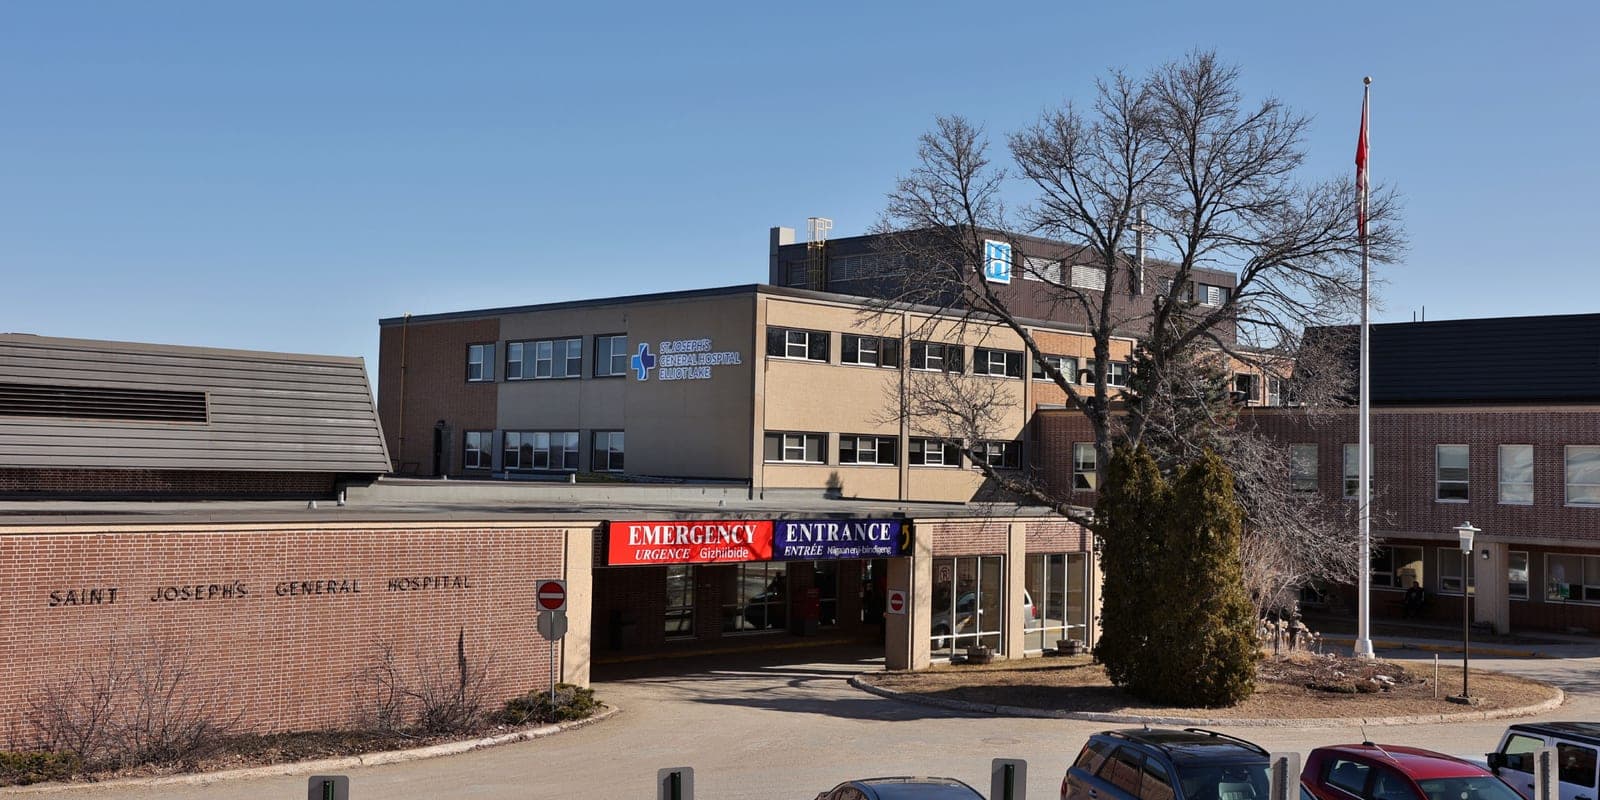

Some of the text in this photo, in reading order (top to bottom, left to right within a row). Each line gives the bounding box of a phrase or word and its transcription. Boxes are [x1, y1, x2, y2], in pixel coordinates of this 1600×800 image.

[660, 352, 740, 367] GENERAL HOSPITAL
[660, 366, 711, 380] ELLIOT LAKE
[627, 522, 892, 546] EMERGENCY ENTRANCE
[635, 546, 750, 561] URGENCE Gizhiibide
[783, 543, 824, 557] ENTRÉE
[49, 575, 472, 607] SAINT JOSEPH'S GENERAL HOSPITAL
